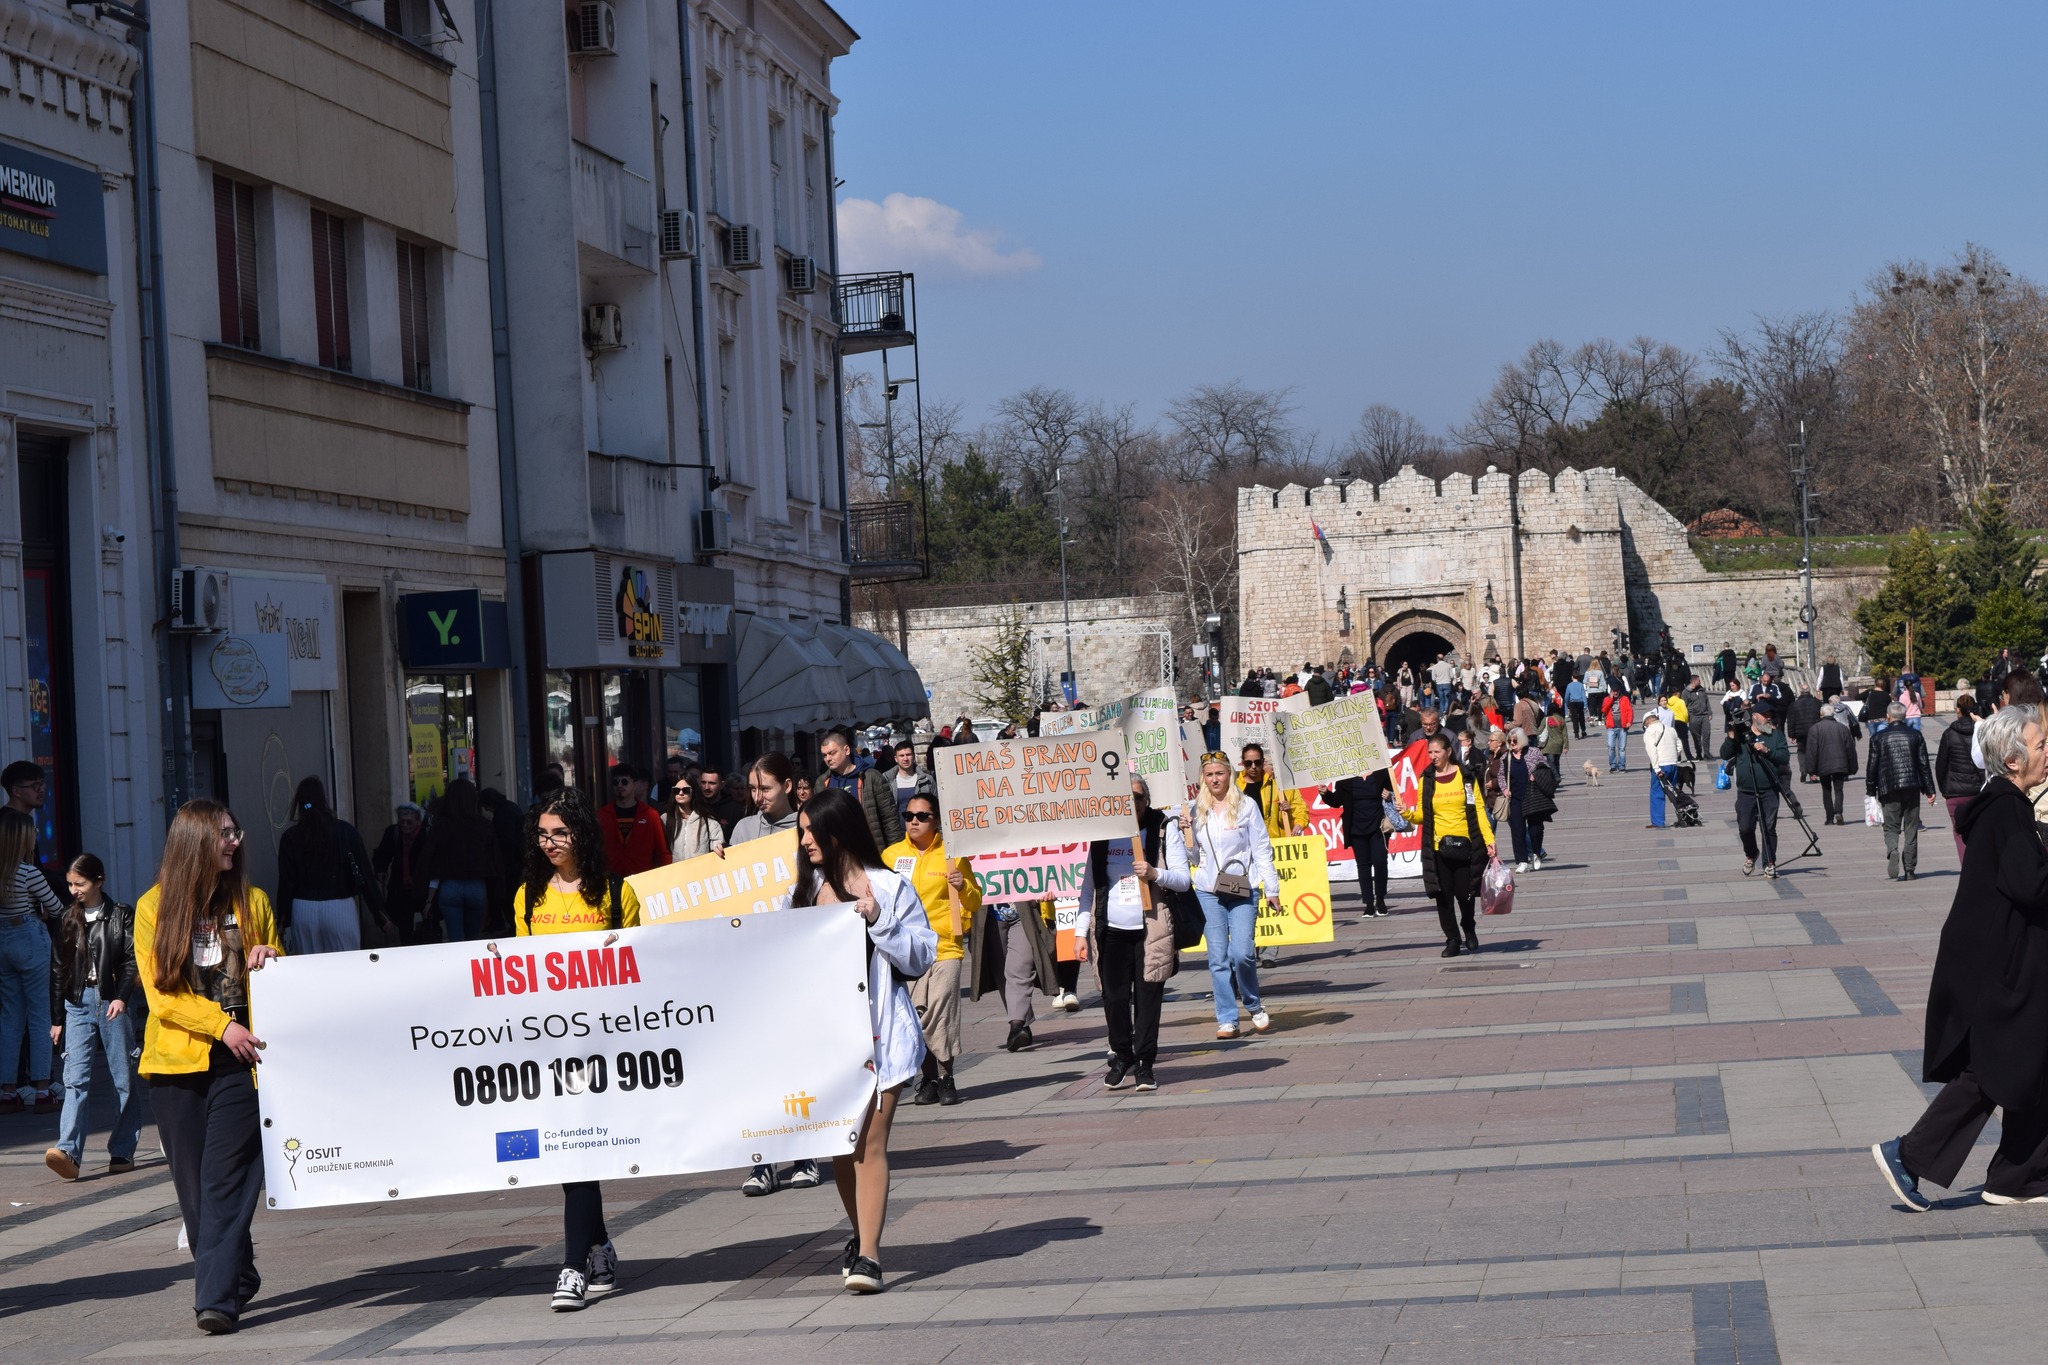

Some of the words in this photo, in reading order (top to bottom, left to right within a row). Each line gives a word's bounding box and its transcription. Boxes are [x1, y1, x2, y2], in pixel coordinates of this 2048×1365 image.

[0, 165, 57, 207] MERKUR
[30, 221, 49, 238] KLUB
[633, 612, 663, 641] SPIN
[1129, 697, 1174, 710] RAZUMEMO
[1143, 711, 1155, 721] TE
[1248, 701, 1279, 713] STOP
[1289, 694, 1374, 730] ROMKINJE
[1135, 727, 1167, 754] 909
[1288, 744, 1309, 759] BEZ
[1313, 731, 1364, 755] RODNO
[1290, 733, 1303, 745] ZA
[954, 742, 1015, 775] IMAŠ
[1023, 740, 1097, 766] PRAVO
[1292, 743, 1380, 772] ZASNOVANOG
[976, 776, 1014, 799] NA
[1021, 767, 1091, 795] ŽIVOT
[949, 805, 989, 831] BEZ
[995, 794, 1132, 825] DISKRIMINACIJE
[643, 851, 798, 920] МАРШИРА
[561, 913, 606, 925] SAMA
[471, 954, 539, 997] NISI
[545, 945, 641, 992] SAMA
[410, 1018, 513, 1050] Pozovi
[521, 1012, 591, 1041] SOS
[599, 1000, 715, 1034] telefon
[453, 1060, 541, 1107] 0800
[547, 1053, 608, 1097] 100
[616, 1047, 684, 1092] 909
[544, 1127, 594, 1140] Co-funded
[595, 1126, 609, 1138] by
[742, 1125, 794, 1139] Ekumenska
[796, 1119, 840, 1133] inicijativa
[305, 1147, 342, 1160] OSVIT
[544, 1142, 559, 1152] the
[561, 1138, 609, 1151] European
[611, 1135, 641, 1147] Union
[307, 1161, 352, 1174] UDRUŽENJE
[353, 1158, 394, 1171] ROMKINJA
